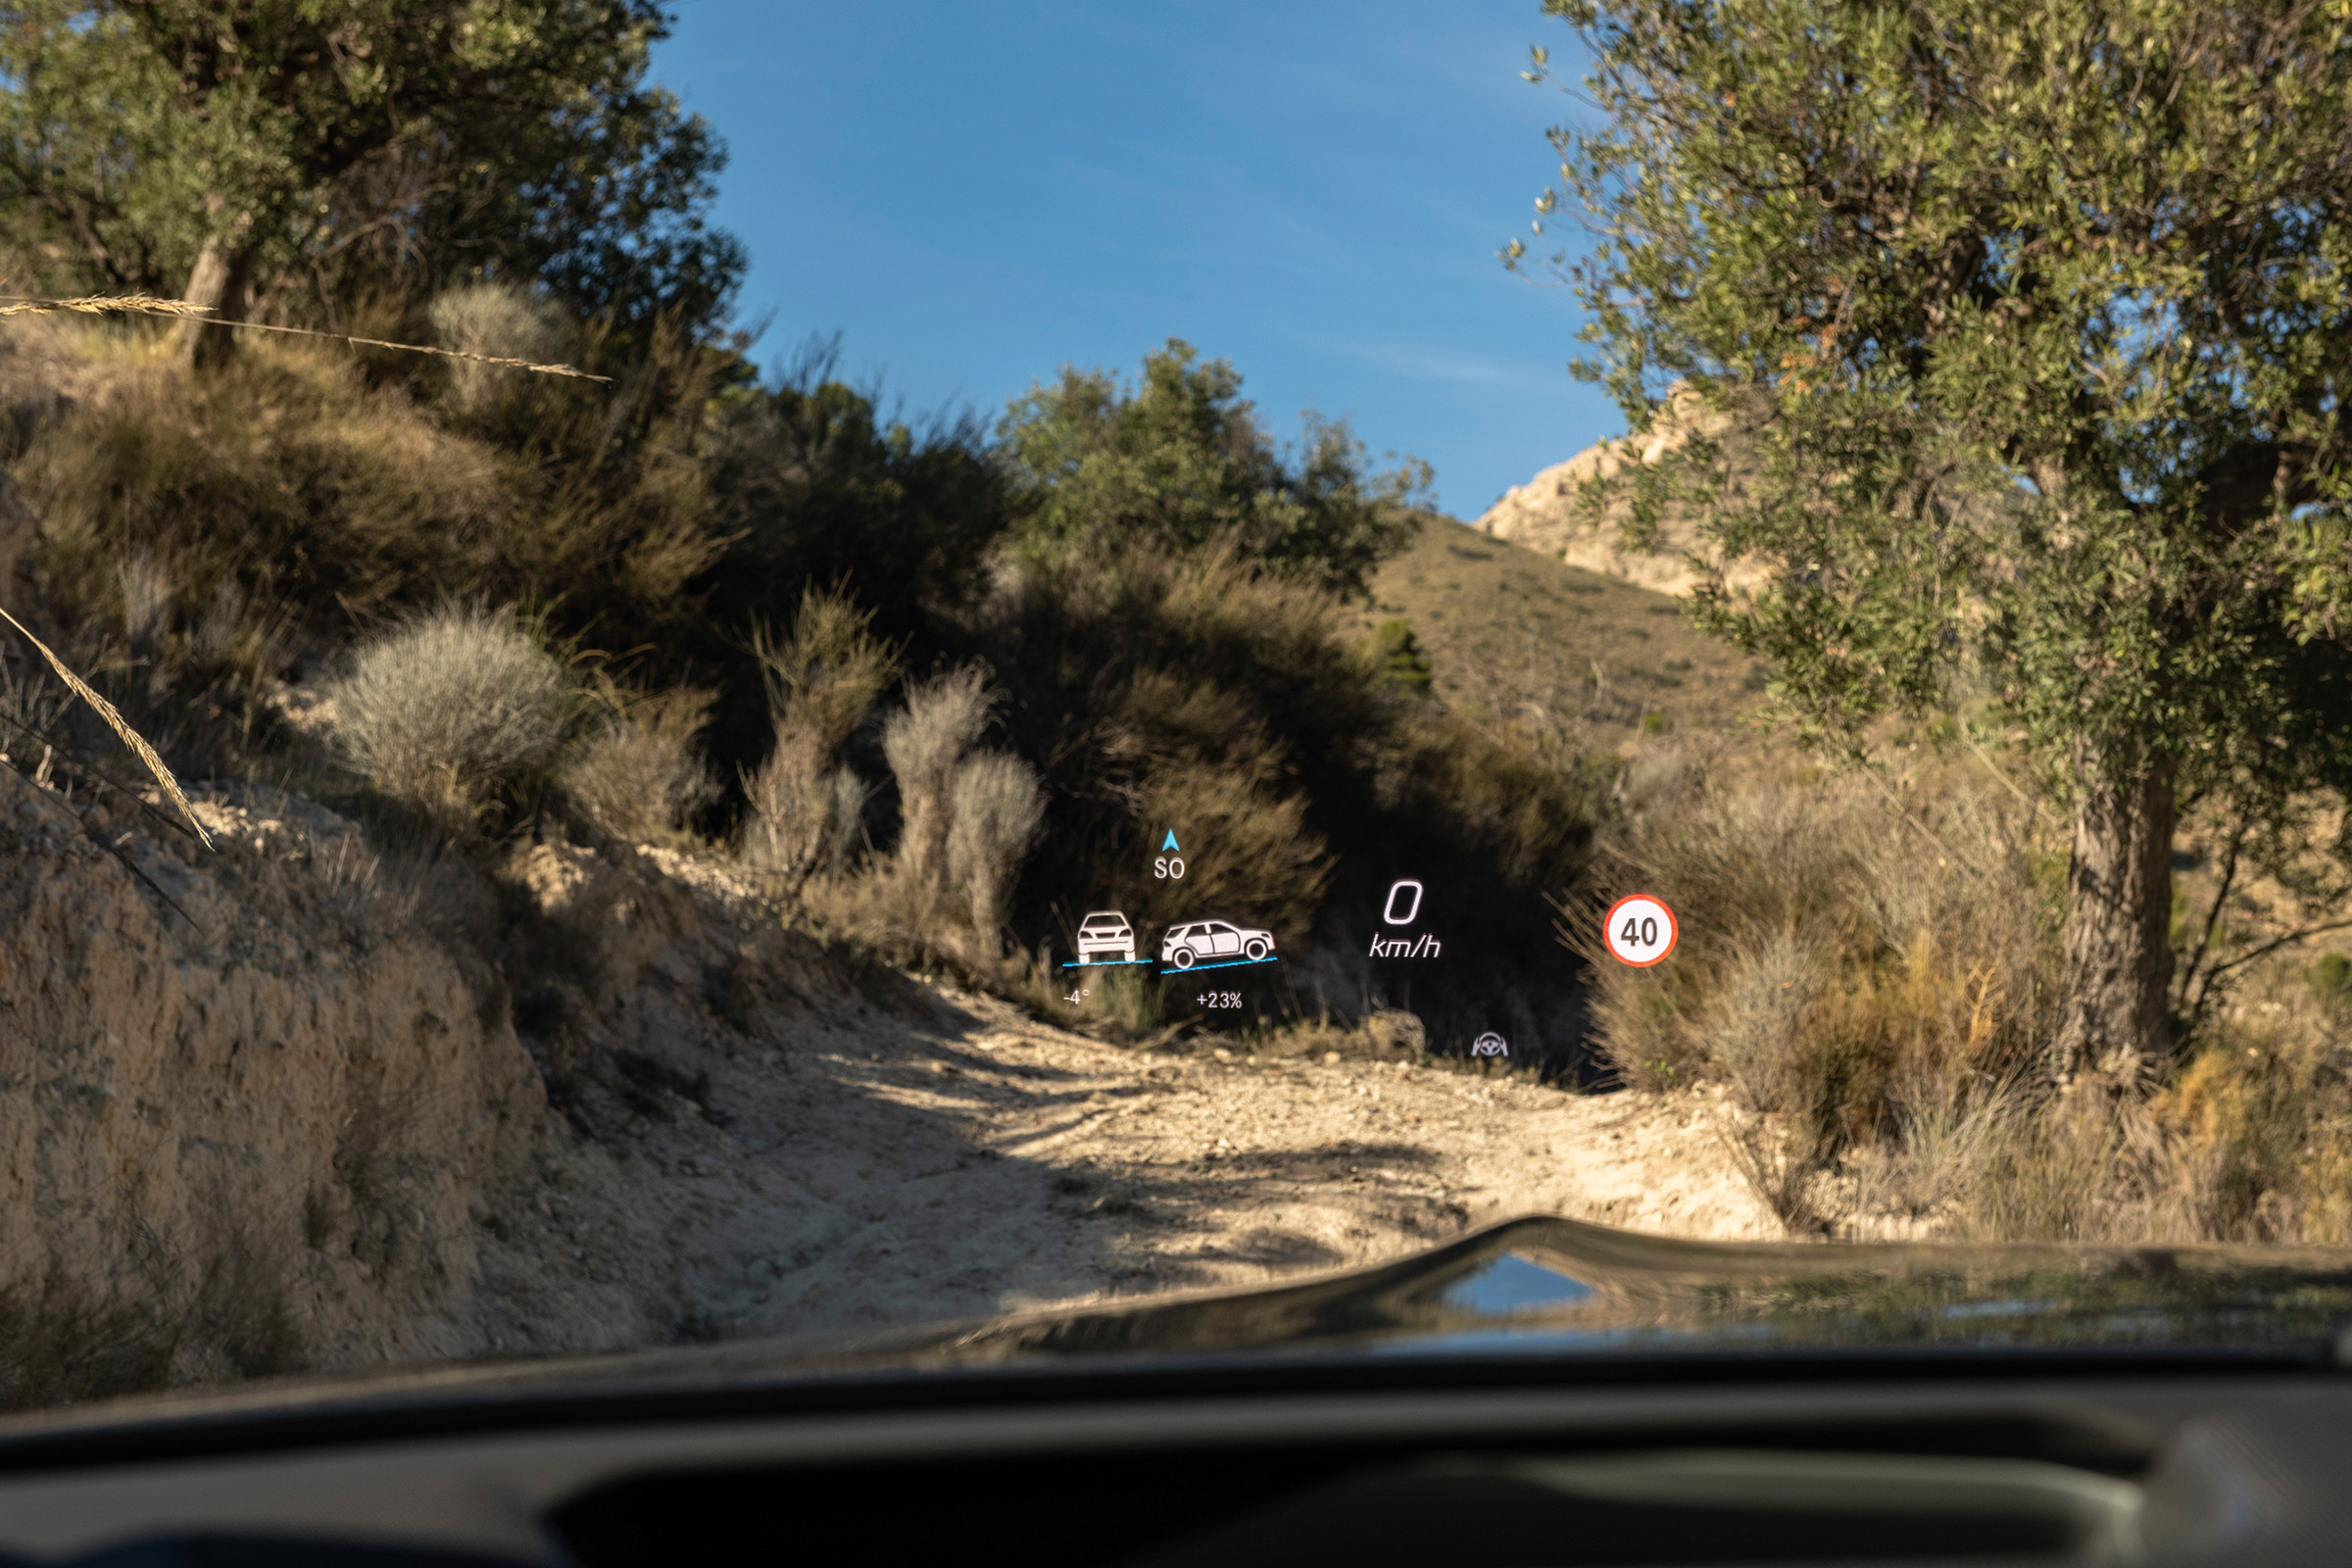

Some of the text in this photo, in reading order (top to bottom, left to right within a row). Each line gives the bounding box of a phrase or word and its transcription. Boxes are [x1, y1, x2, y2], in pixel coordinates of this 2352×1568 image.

[1154, 857, 1185, 879] SO
[1384, 880, 1423, 925] 0
[1369, 932, 1441, 957] km/h
[1620, 916, 1658, 948] 40
[1197, 991, 1243, 1008] +23%
